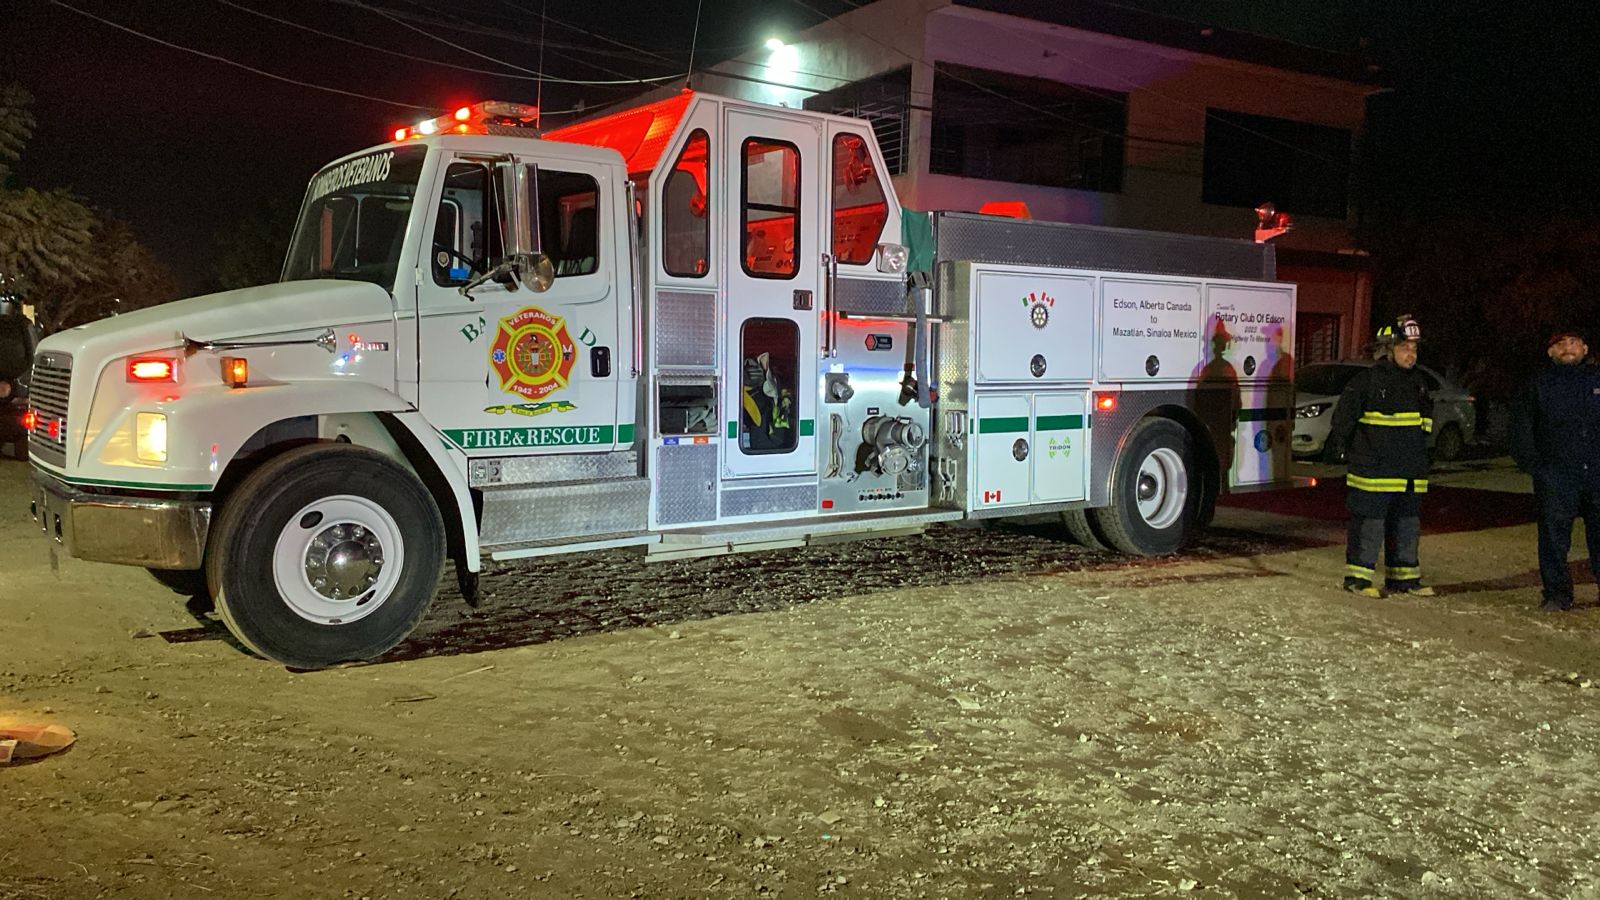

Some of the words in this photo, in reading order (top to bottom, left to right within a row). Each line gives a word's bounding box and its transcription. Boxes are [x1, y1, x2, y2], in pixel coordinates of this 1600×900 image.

[1113, 299, 1138, 310] Edson,
[1140, 300, 1165, 310] Alberta
[1166, 301, 1192, 311] Canada
[508, 312, 556, 326] VETERANOS
[1150, 315, 1158, 324] to
[1215, 312, 1238, 324] Rotary
[1240, 313, 1255, 322] Club
[1256, 313, 1264, 323] Of
[1265, 314, 1285, 324] Edson
[1146, 328, 1172, 338] Sinaloa
[1173, 328, 1198, 339] Mexico
[1408, 326, 1417, 335] 12
[513, 384, 532, 395] 1942
[538, 382, 558, 394] 2004
